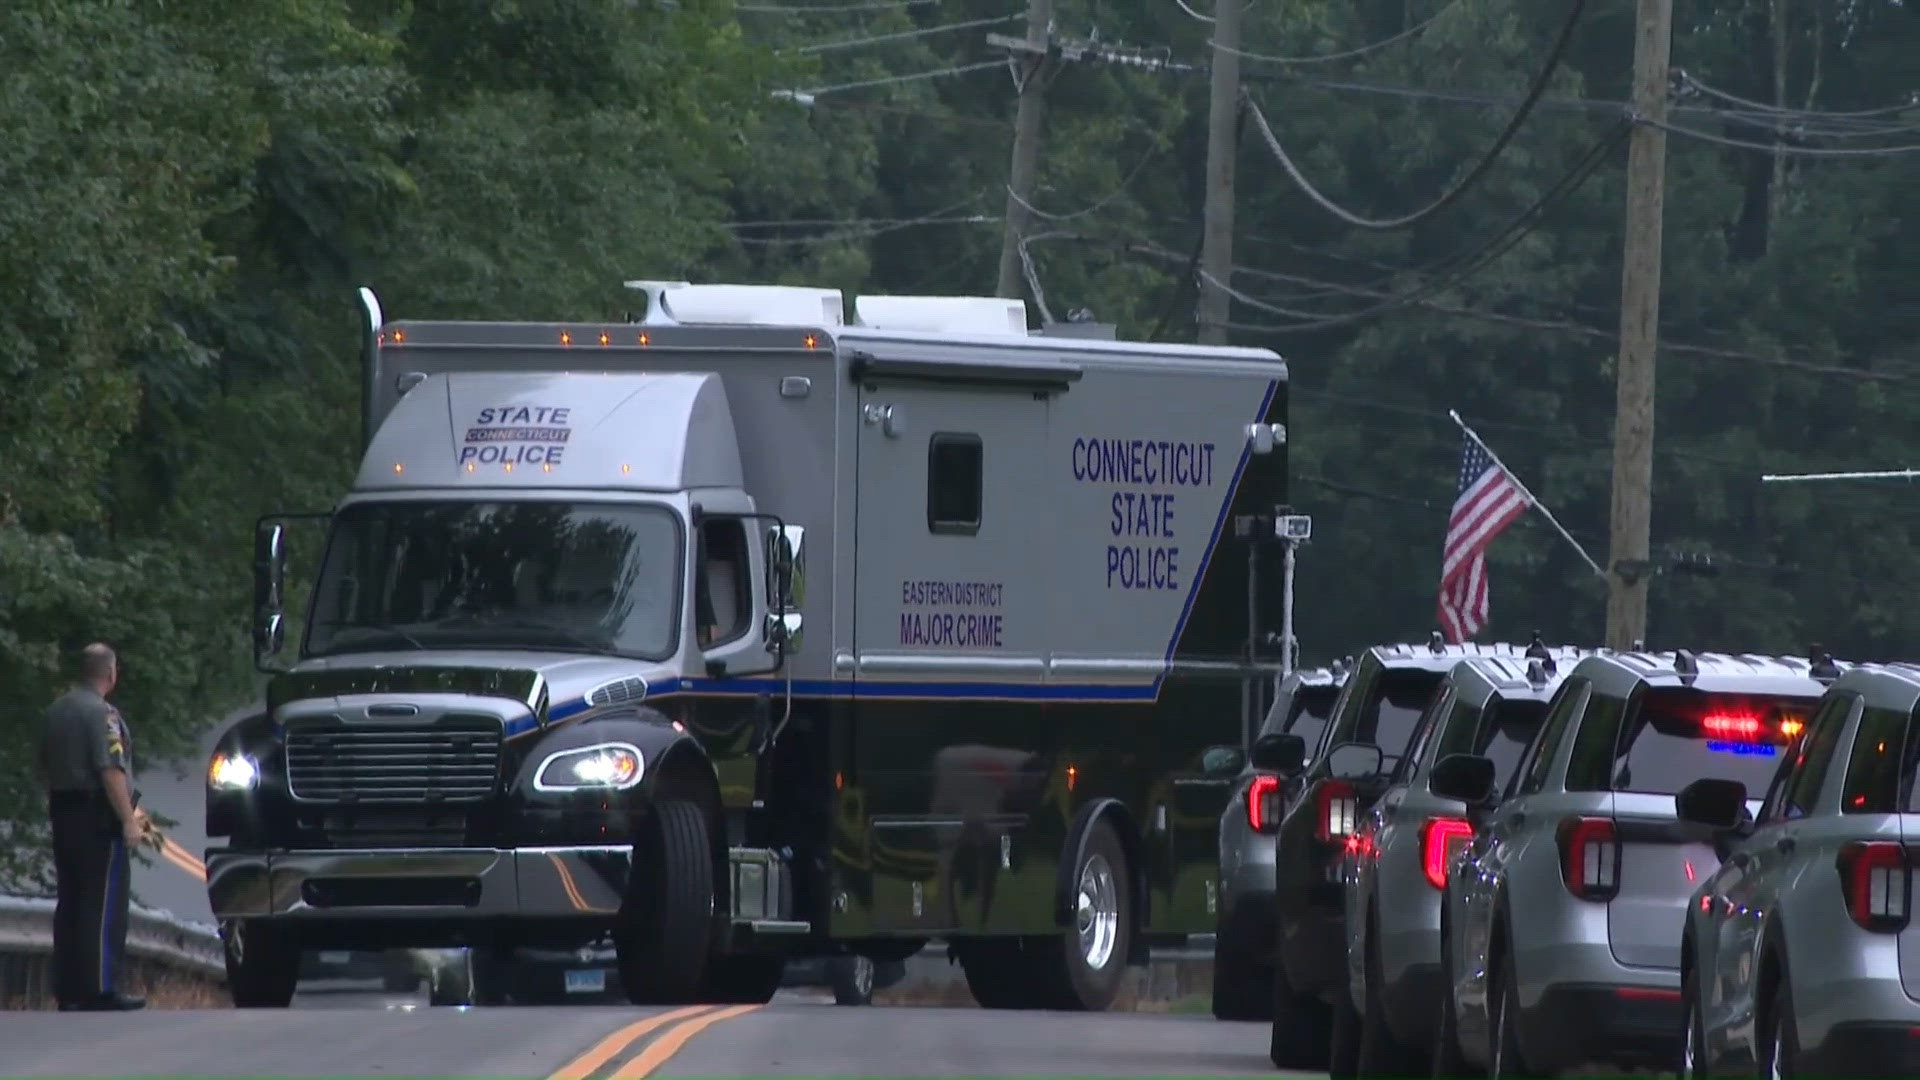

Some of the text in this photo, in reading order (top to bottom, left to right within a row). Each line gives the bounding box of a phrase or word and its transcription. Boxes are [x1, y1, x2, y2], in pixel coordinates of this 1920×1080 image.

[477, 407, 570, 424] STATE
[466, 429, 569, 441] CONNECTICUT
[460, 446, 564, 464] POLICE
[1073, 438, 1215, 486] CONNECTICUT
[1111, 492, 1175, 537] STATE
[1107, 545, 1179, 590] POLICE
[903, 581, 1003, 607] EASTERN DISTRICT
[901, 613, 1003, 647] MAJOR CRIME
